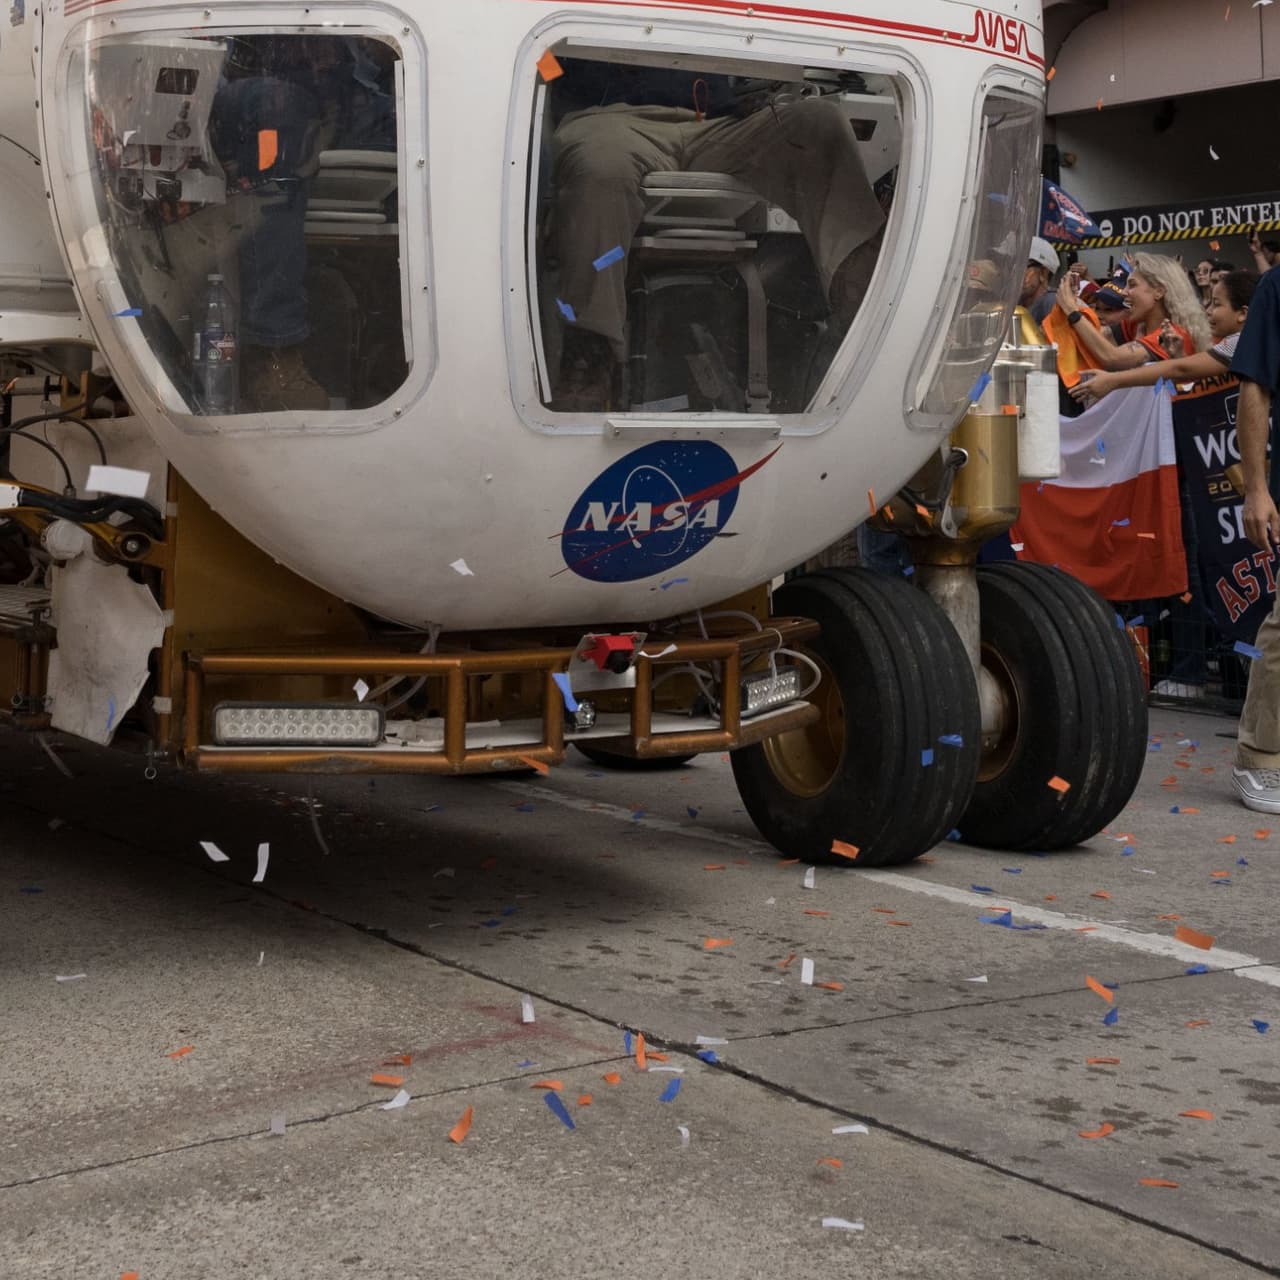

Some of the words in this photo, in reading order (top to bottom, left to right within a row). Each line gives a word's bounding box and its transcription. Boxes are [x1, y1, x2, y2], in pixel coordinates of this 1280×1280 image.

[973, 9, 1032, 57] NASA
[1123, 215, 1153, 237] DO
[1159, 209, 1204, 233] NOT
[576, 499, 721, 532] NASA
